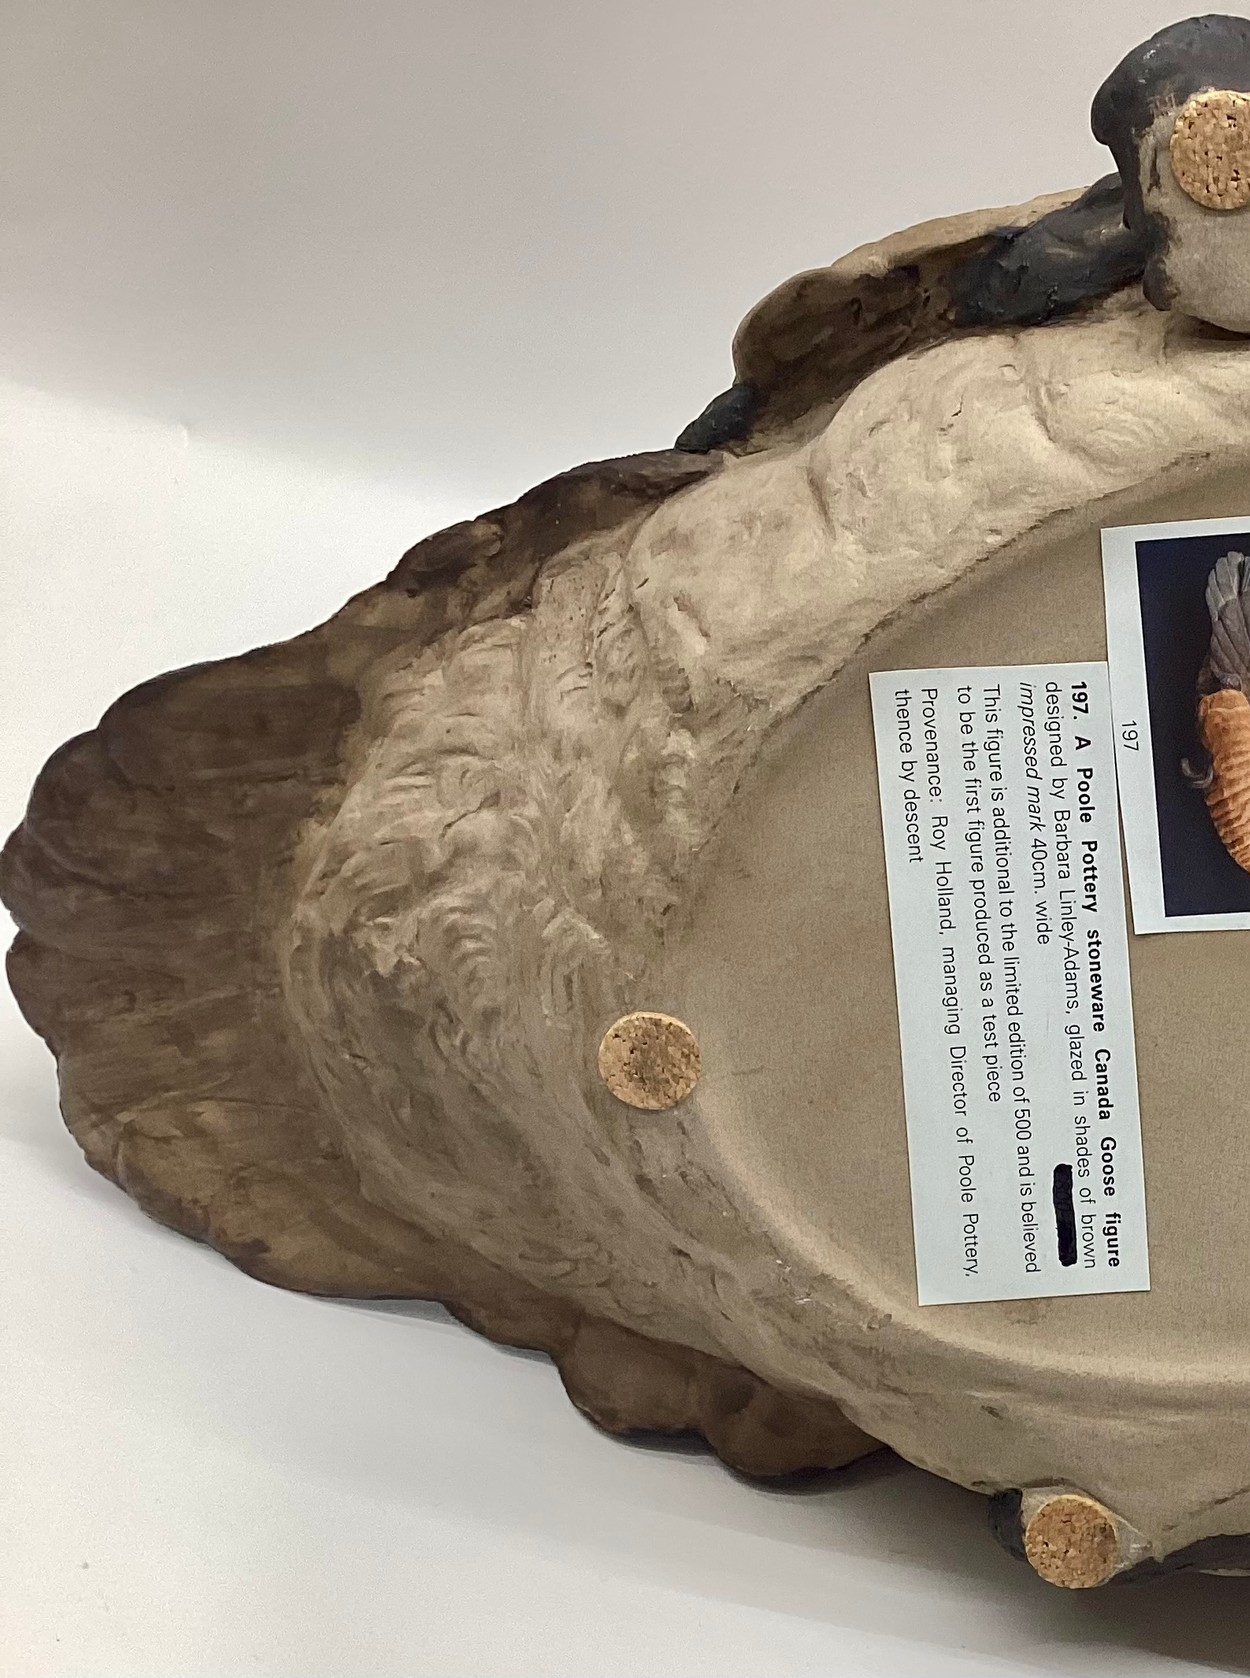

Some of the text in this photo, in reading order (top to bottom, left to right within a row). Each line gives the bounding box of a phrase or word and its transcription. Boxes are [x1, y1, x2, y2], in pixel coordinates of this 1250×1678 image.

[894, 688, 924, 864] thence by descent
[920, 688, 979, 1277] Provenance: Roy Holland, managing Director of Poole Pottery,
[957, 685, 1004, 1103] to be the first figure produced as a test piece
[983, 683, 1042, 1273] This figure is additional to the limited edition of 500 and is believed
[1016, 682, 1054, 945] impressed mark 40cm. wide
[1043, 681, 1097, 1269] designed by Barbara Linley-Adams, glazed in shades of brown
[1071, 681, 1122, 1268] 197. A Poole Pottery stoneware Canada Goose figure
[1122, 720, 1139, 751] 197
